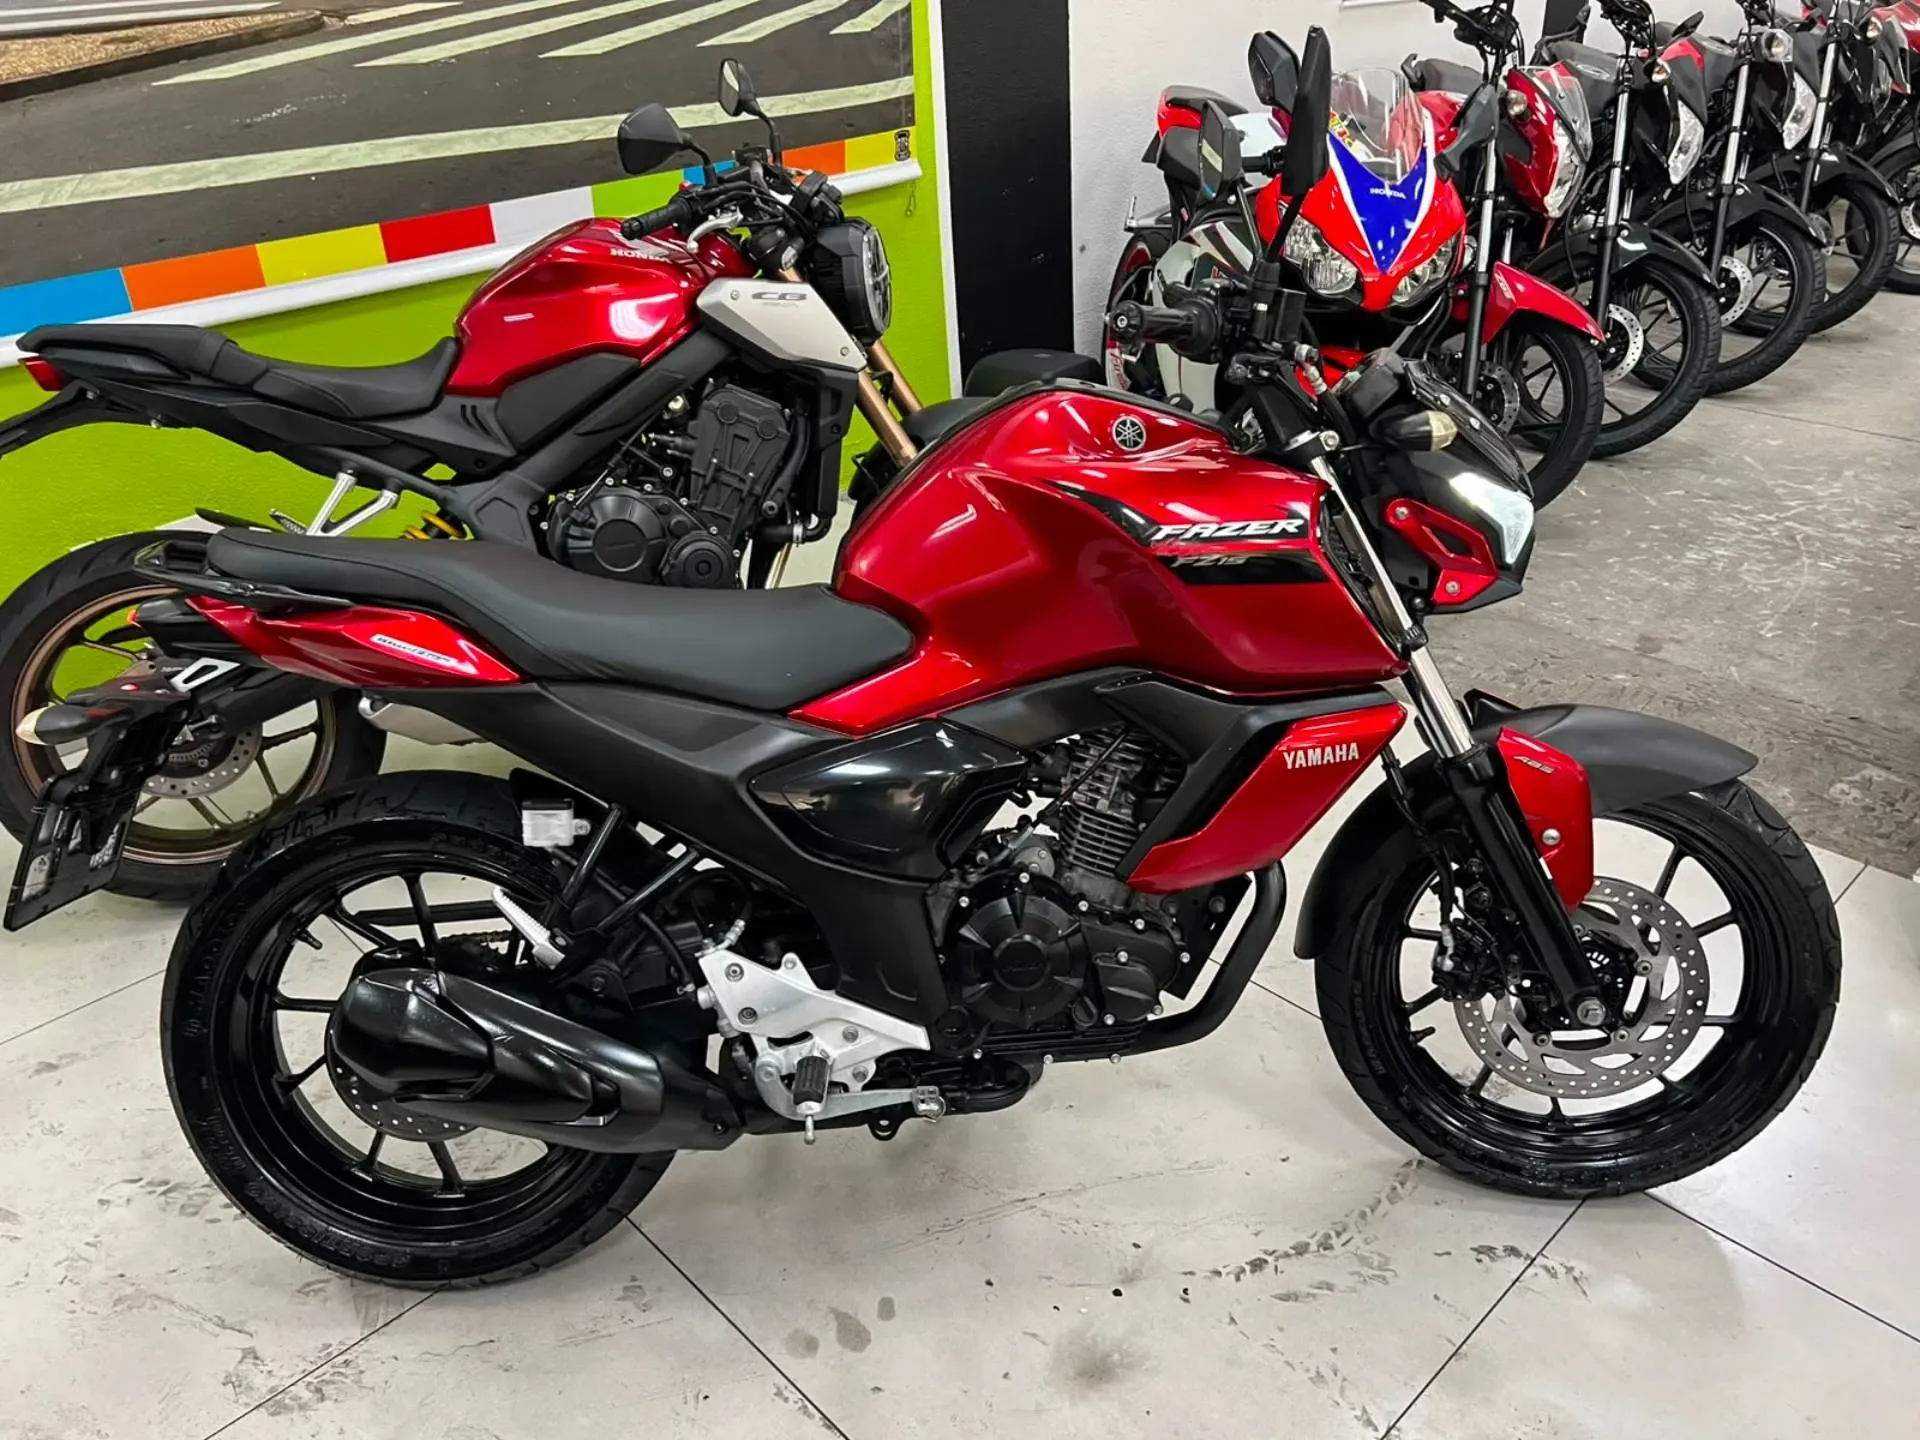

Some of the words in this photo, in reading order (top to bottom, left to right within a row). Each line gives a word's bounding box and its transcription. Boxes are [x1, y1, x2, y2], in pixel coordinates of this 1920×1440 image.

[752, 292, 807, 300] CB
[1150, 519, 1305, 540] FAZER
[1283, 742, 1360, 770] YAMAHA
